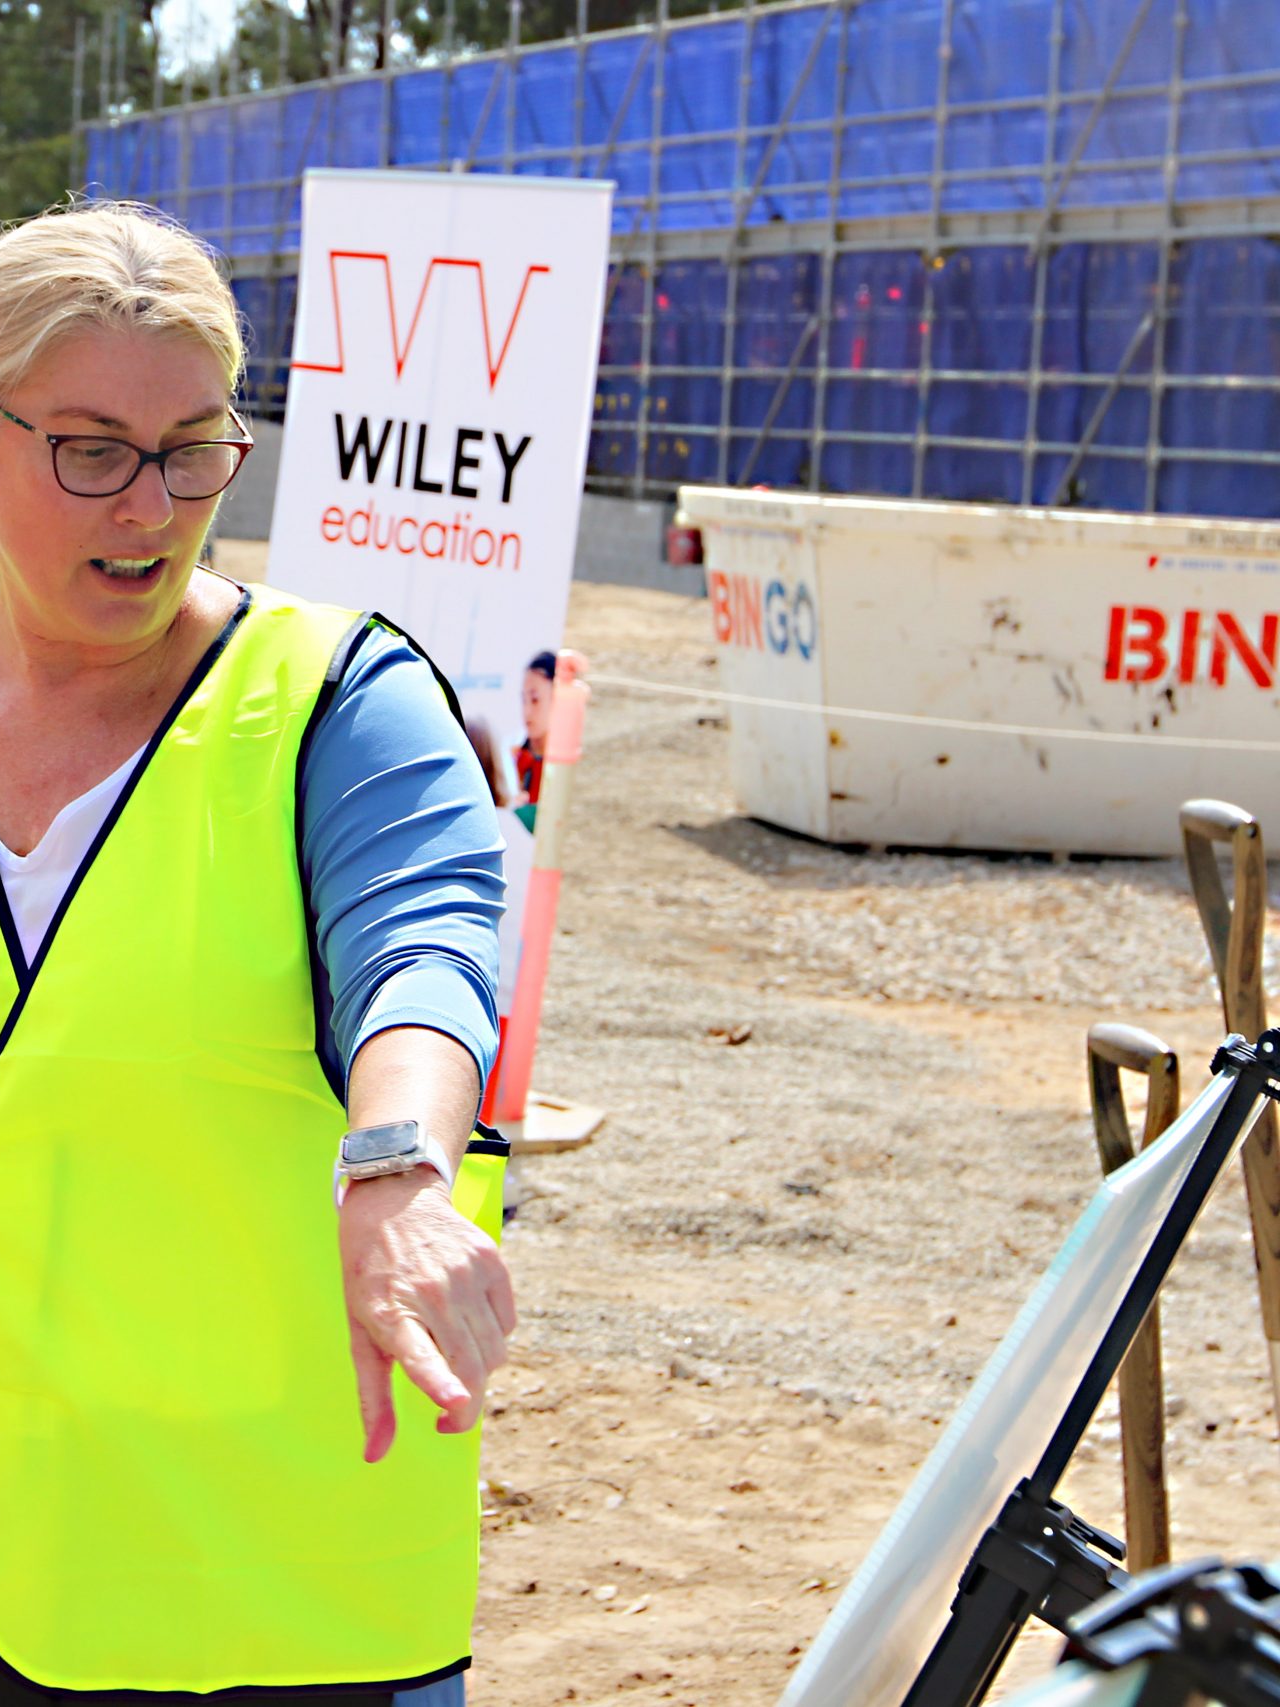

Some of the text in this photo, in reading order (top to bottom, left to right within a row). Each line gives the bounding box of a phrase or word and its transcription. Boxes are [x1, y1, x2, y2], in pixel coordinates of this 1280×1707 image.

[334, 412, 532, 504] WILEY
[320, 500, 522, 570] education
[710, 570, 817, 662] BINGO
